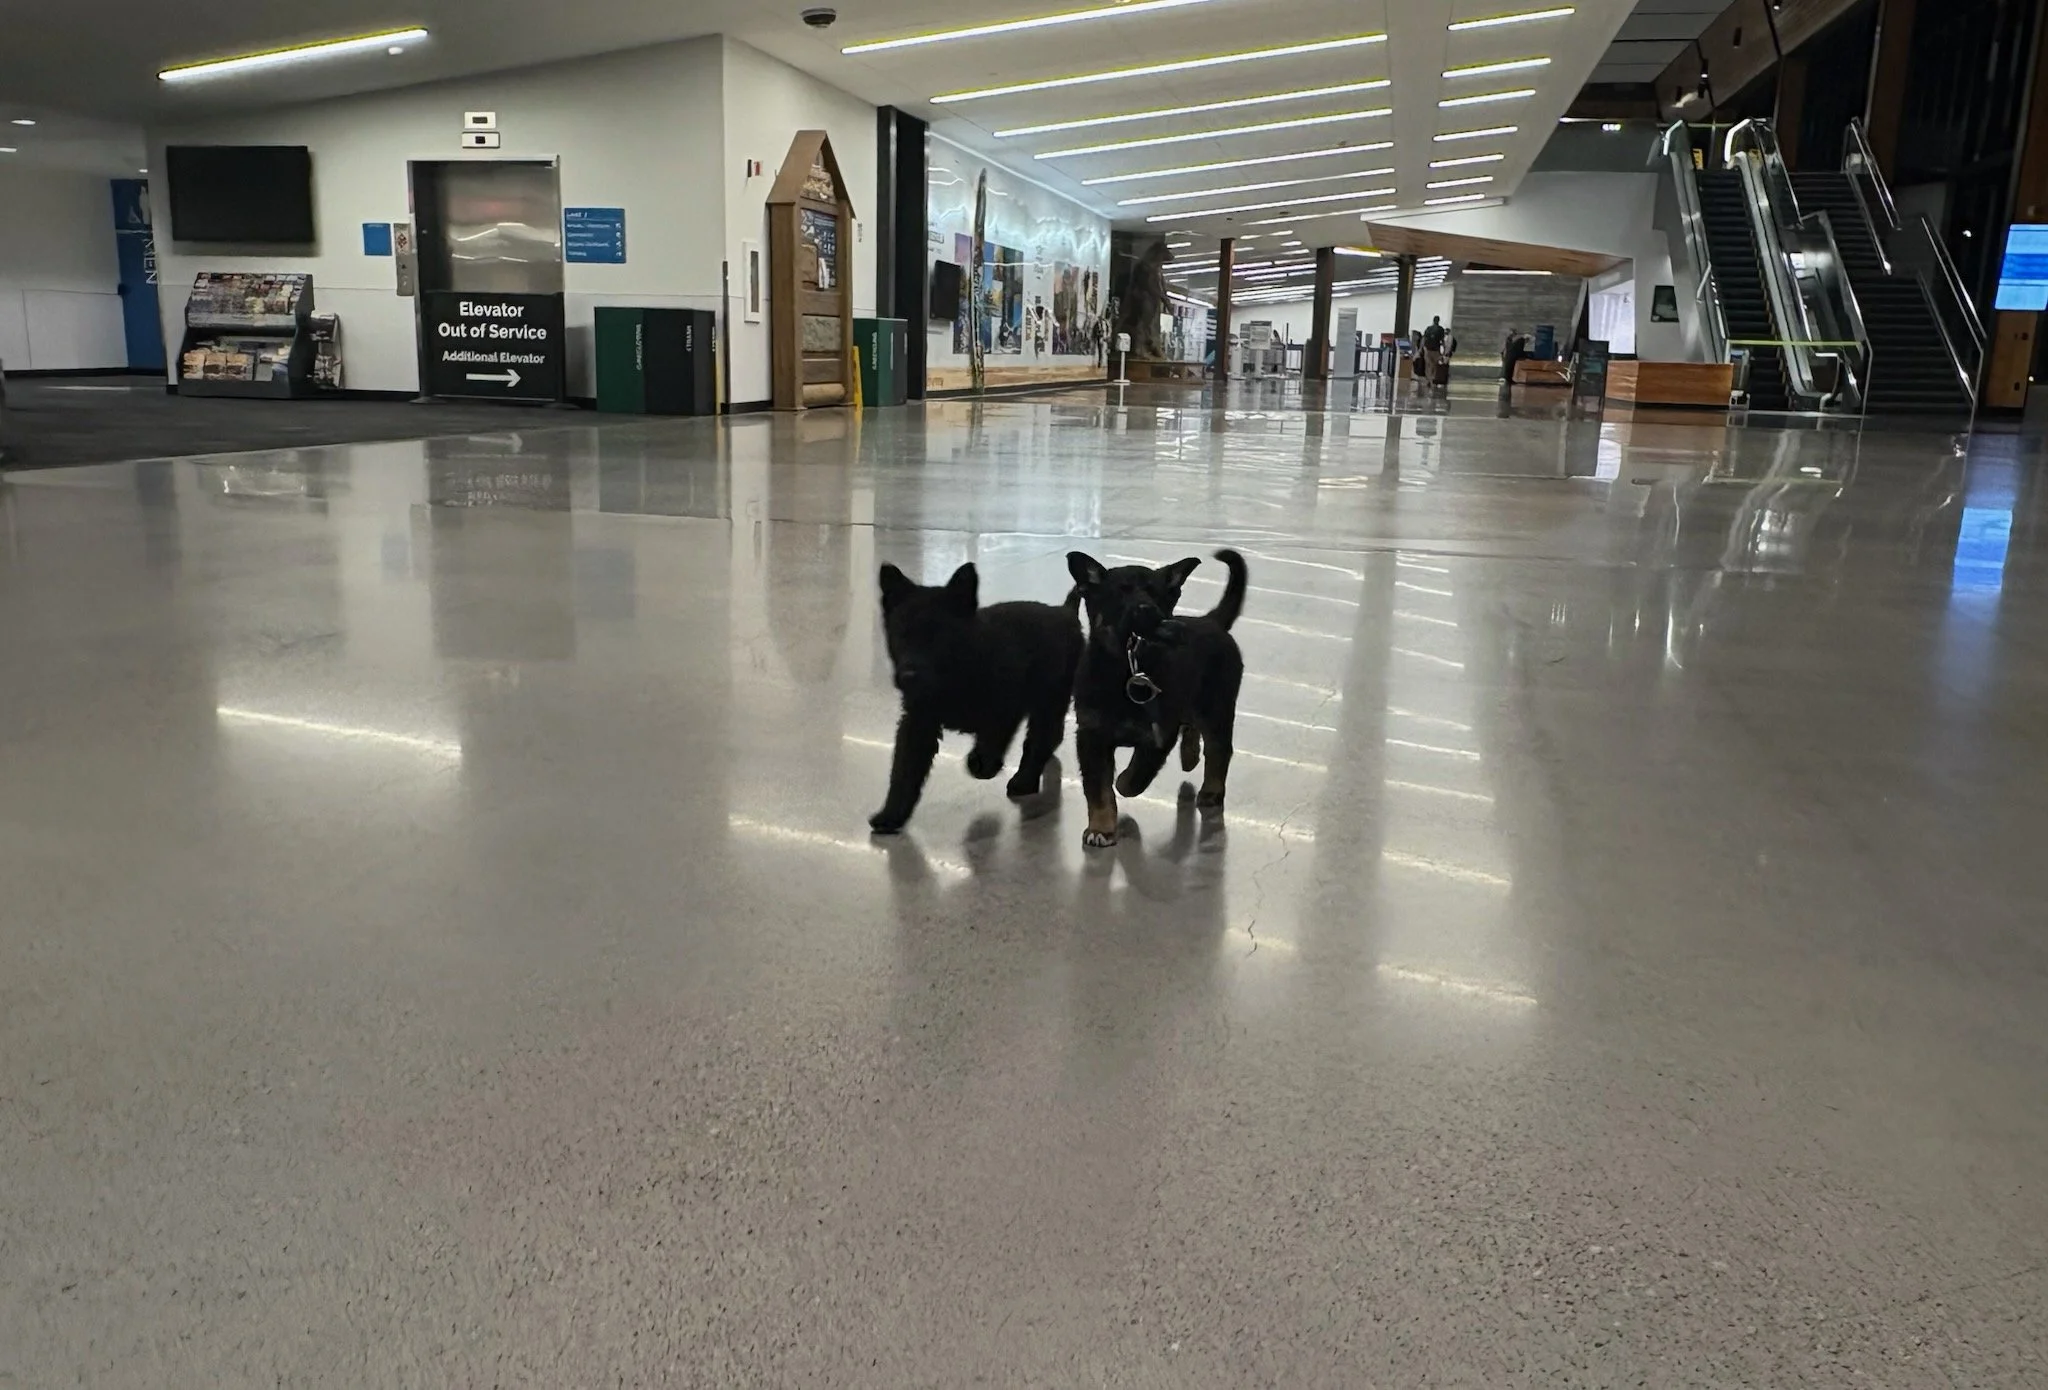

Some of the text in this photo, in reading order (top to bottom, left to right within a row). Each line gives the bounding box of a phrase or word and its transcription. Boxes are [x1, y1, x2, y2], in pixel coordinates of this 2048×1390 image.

[142, 238, 158, 285] MEN
[459, 301, 525, 318] Elevator
[438, 322, 547, 340] Out of Service
[442, 350, 546, 364] Additional Elevator
